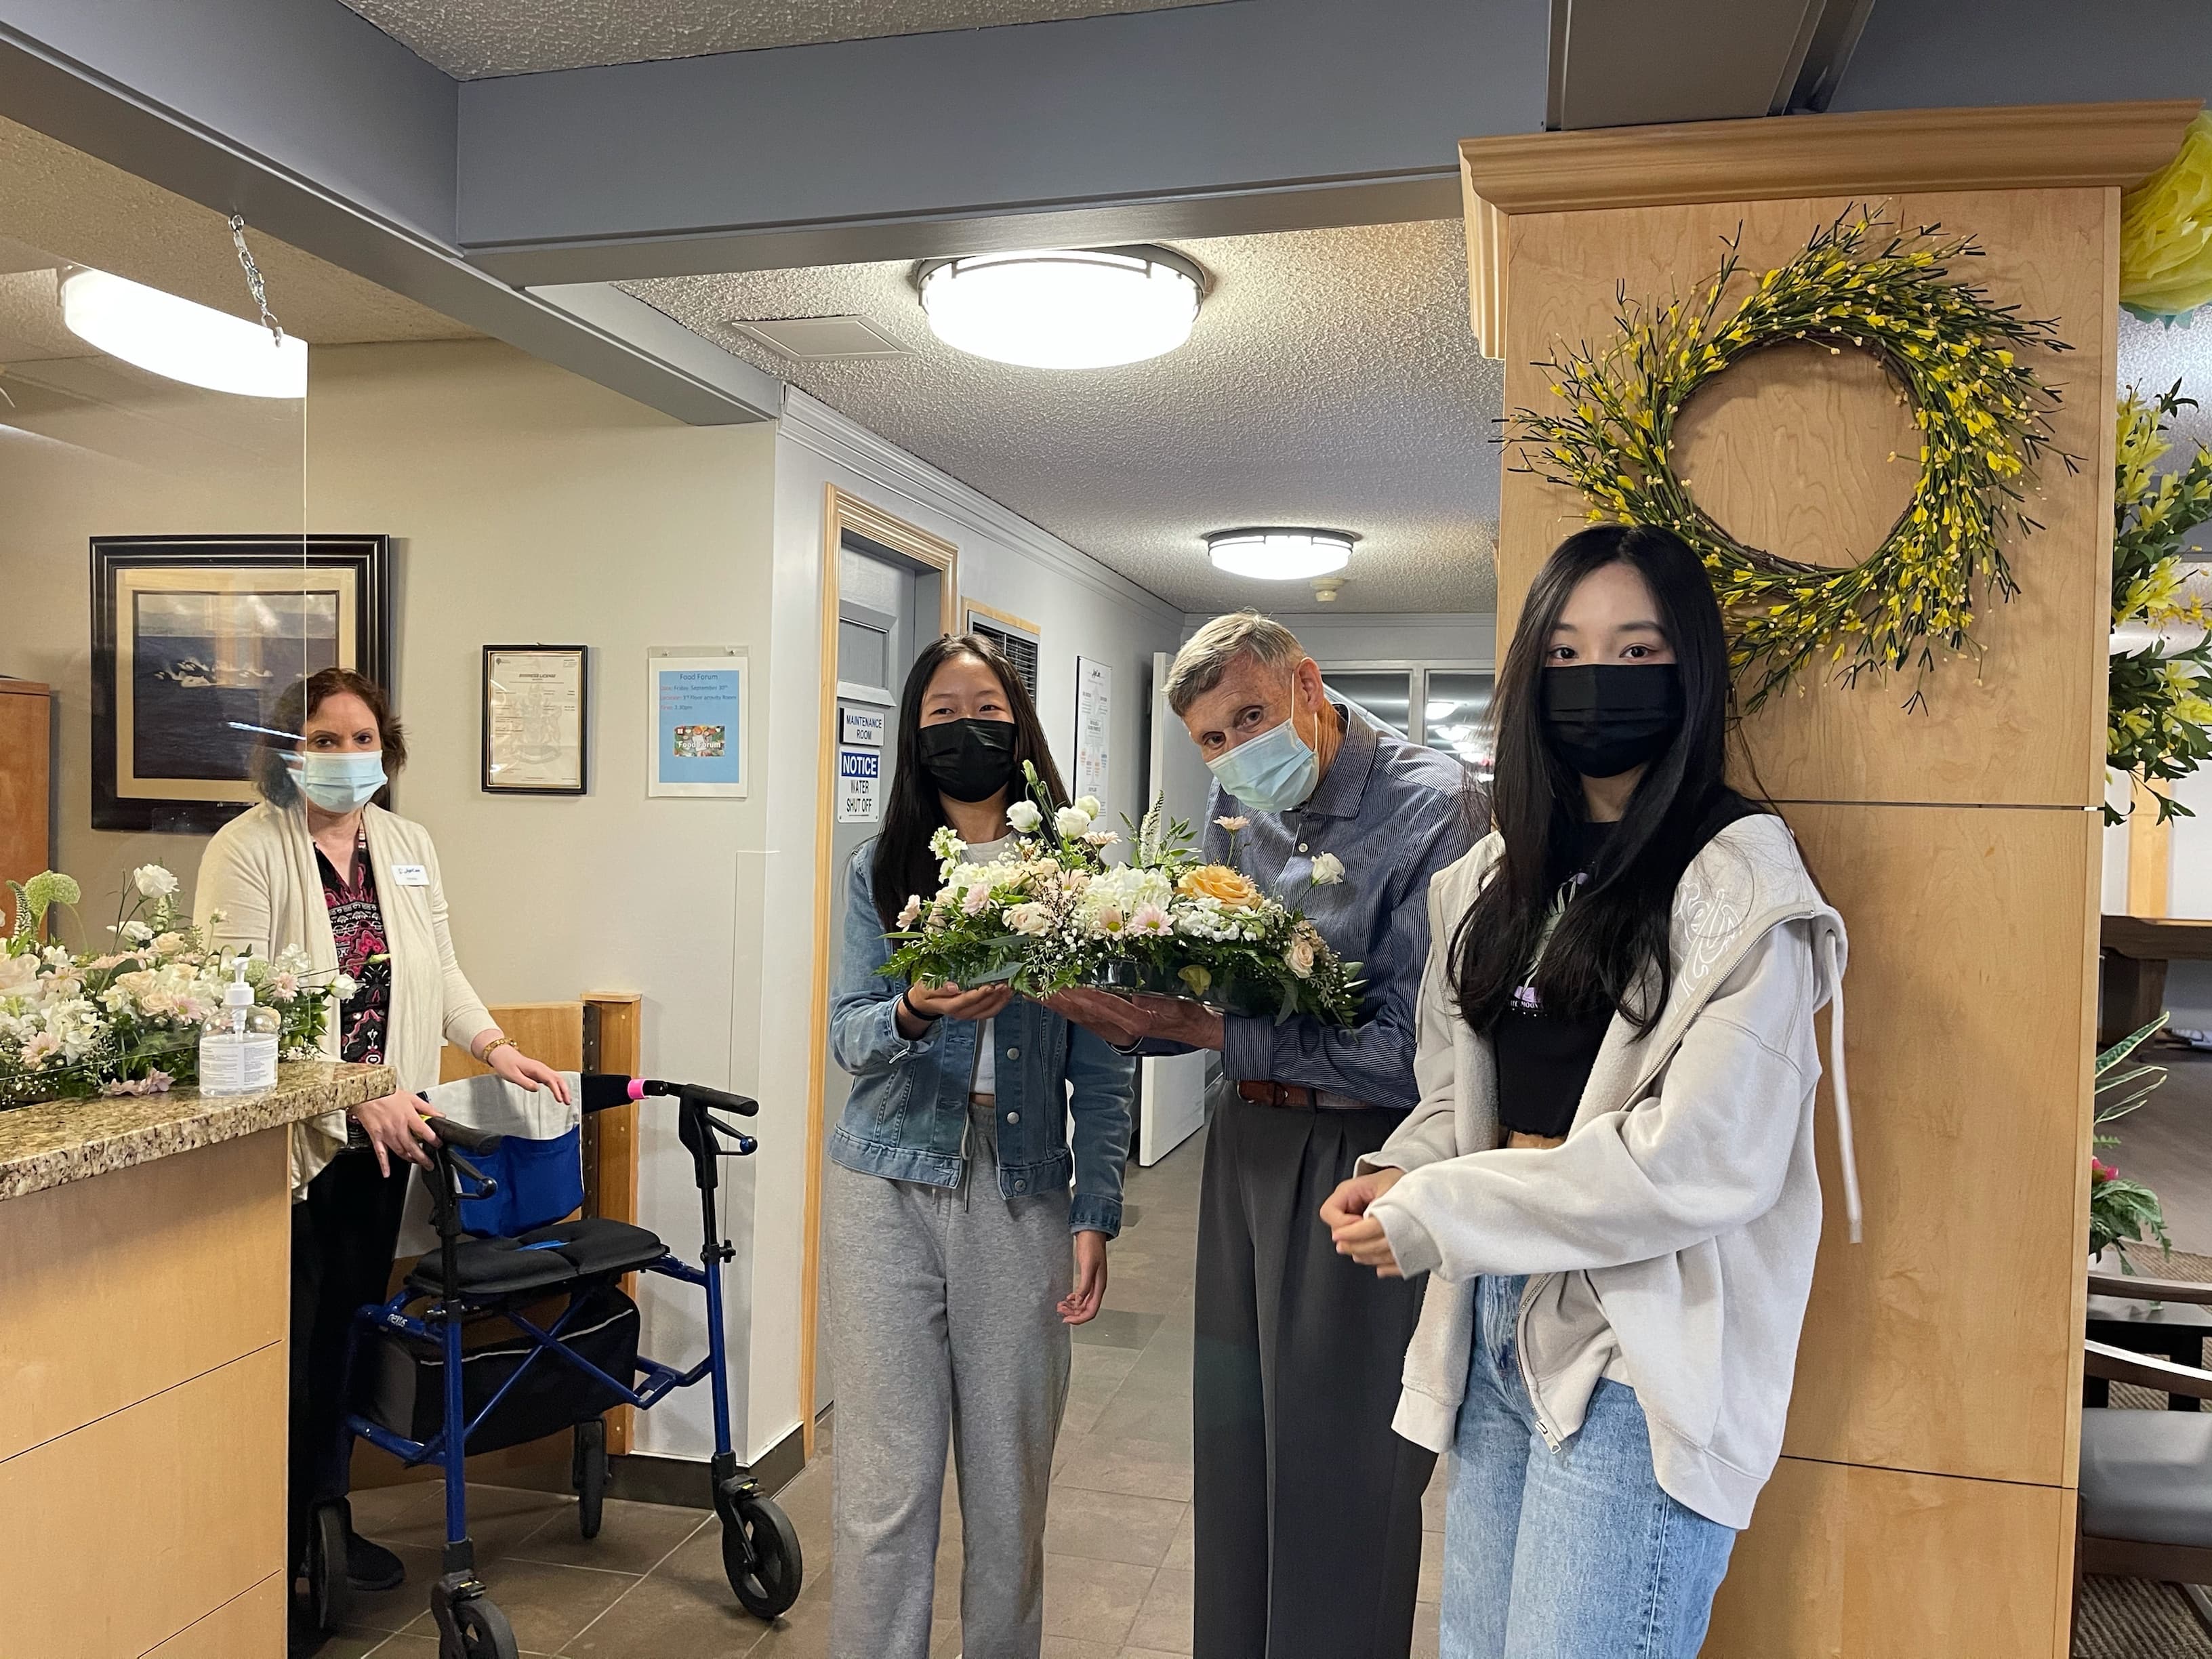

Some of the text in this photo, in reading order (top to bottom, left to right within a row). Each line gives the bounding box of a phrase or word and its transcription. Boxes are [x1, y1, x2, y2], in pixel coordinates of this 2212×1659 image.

[846, 715, 882, 729] MAINTENANCE
[857, 729, 872, 740] ROOM
[842, 755, 877, 775] NOTICE
[851, 780, 869, 794] WATER
[846, 798, 872, 813] SHUT OFF
